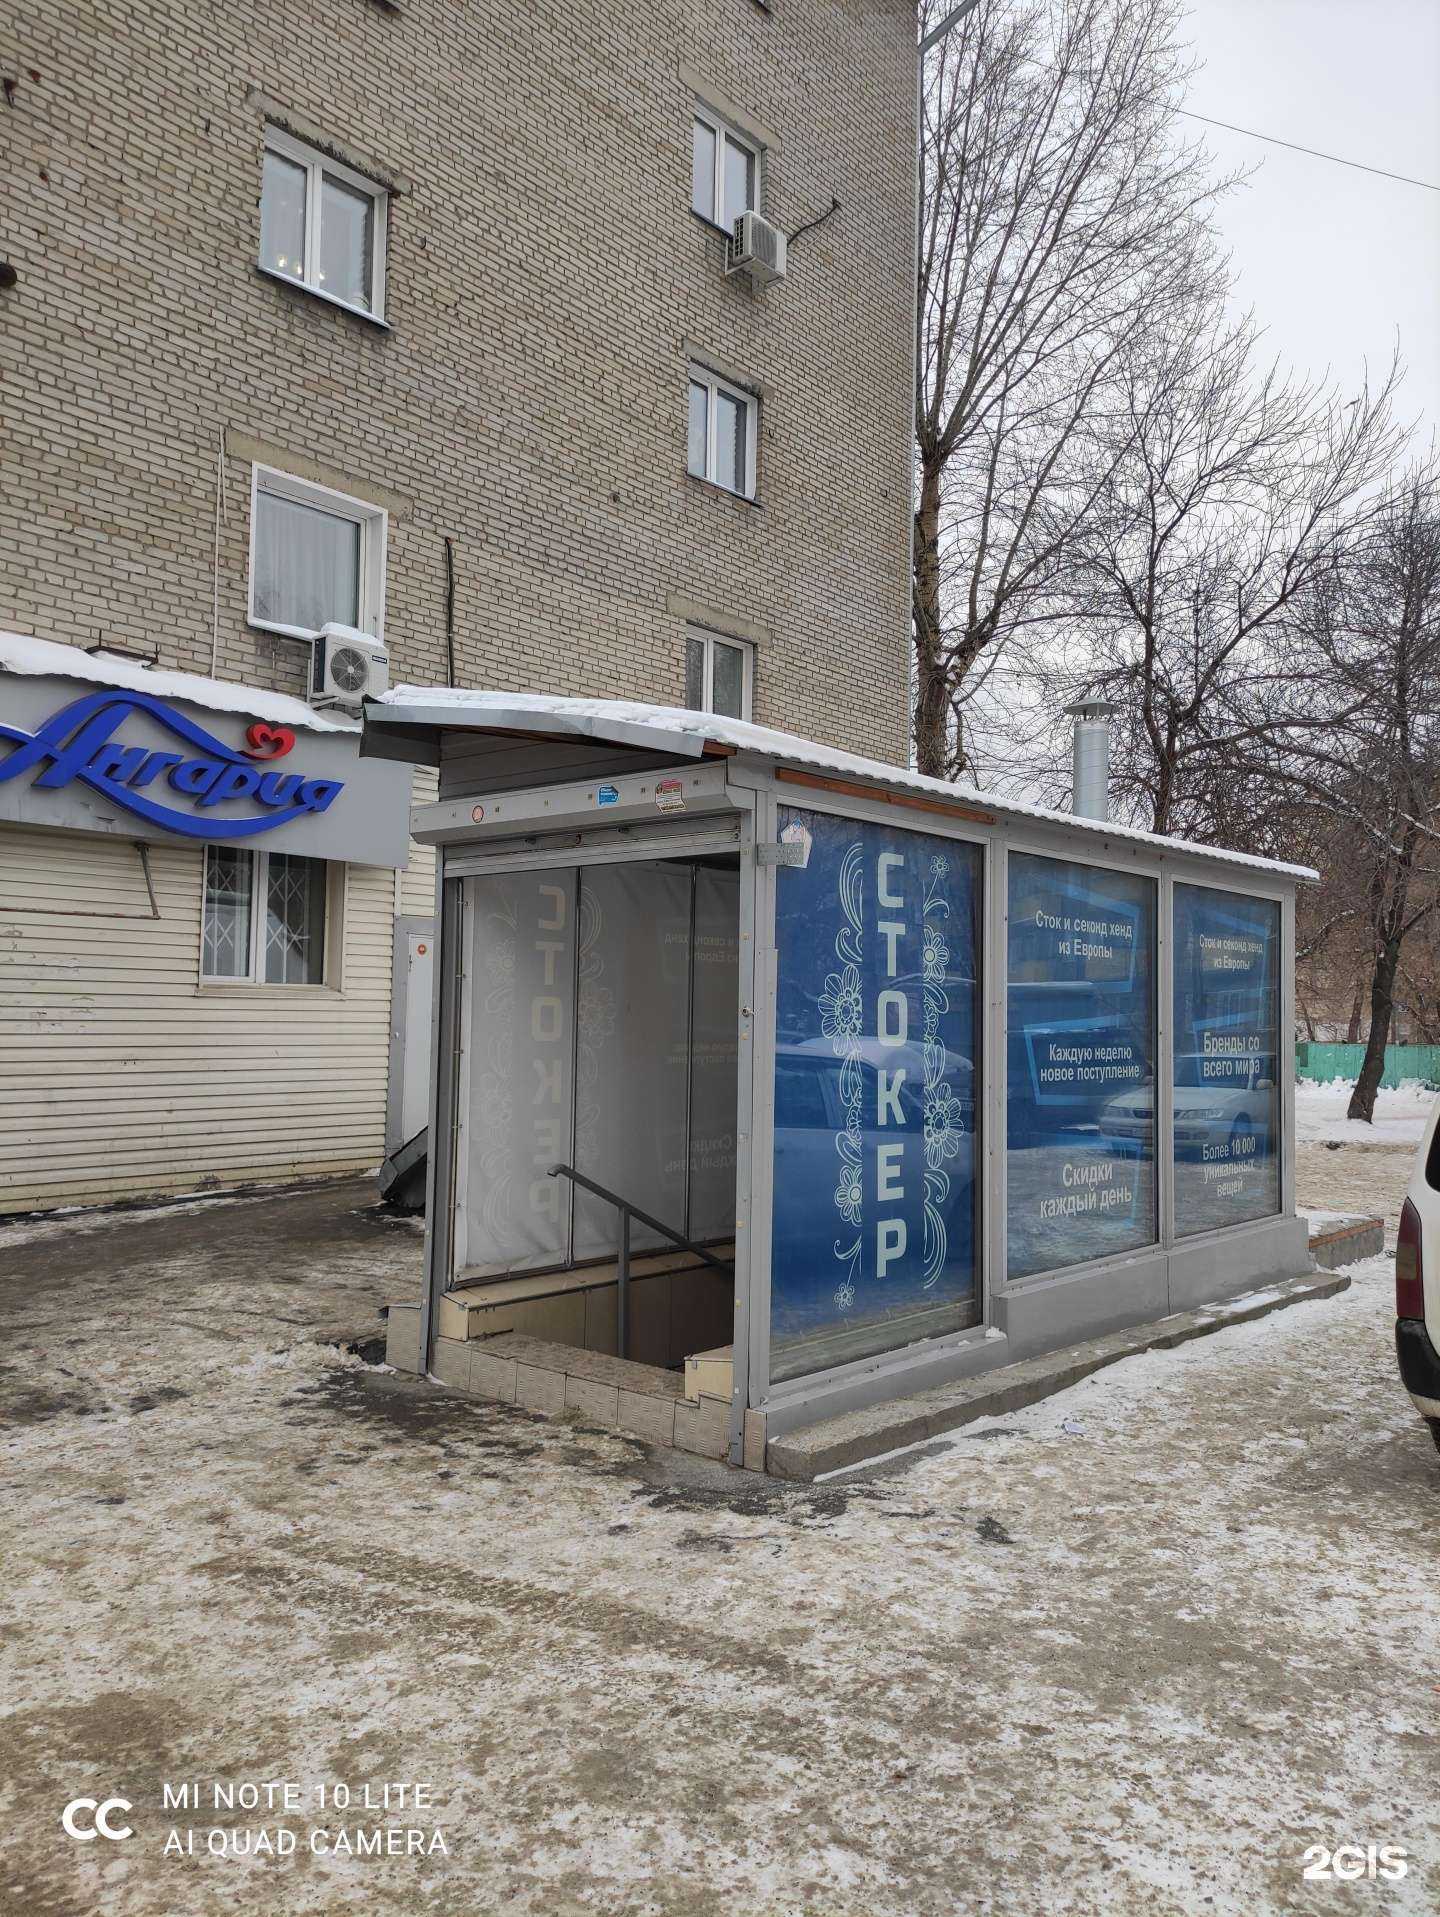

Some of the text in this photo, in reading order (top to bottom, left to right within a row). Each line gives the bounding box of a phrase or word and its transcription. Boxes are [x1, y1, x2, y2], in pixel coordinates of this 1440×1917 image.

[0, 691, 345, 818] Ангария
[1035, 910, 1133, 941] Сток и секонд хенд
[1058, 939, 1113, 960] из Европы
[1200, 934, 1216, 951] Сток
[1223, 955, 1250, 972] Европы
[1049, 1043, 1132, 1065] Каждую неделю
[1203, 1031, 1260, 1057] Бренды со
[875, 852, 908, 1279] СТОКЕР
[1040, 1065, 1140, 1084] новое поступление
[1203, 1058, 1260, 1077] всего мира
[1202, 1135, 1256, 1161] Более 10 000
[1062, 1163, 1113, 1188] Скидки
[1203, 1158, 1255, 1185] уникальных
[1217, 1177, 1243, 1198] вещей
[1040, 1183, 1132, 1219] каждый день
